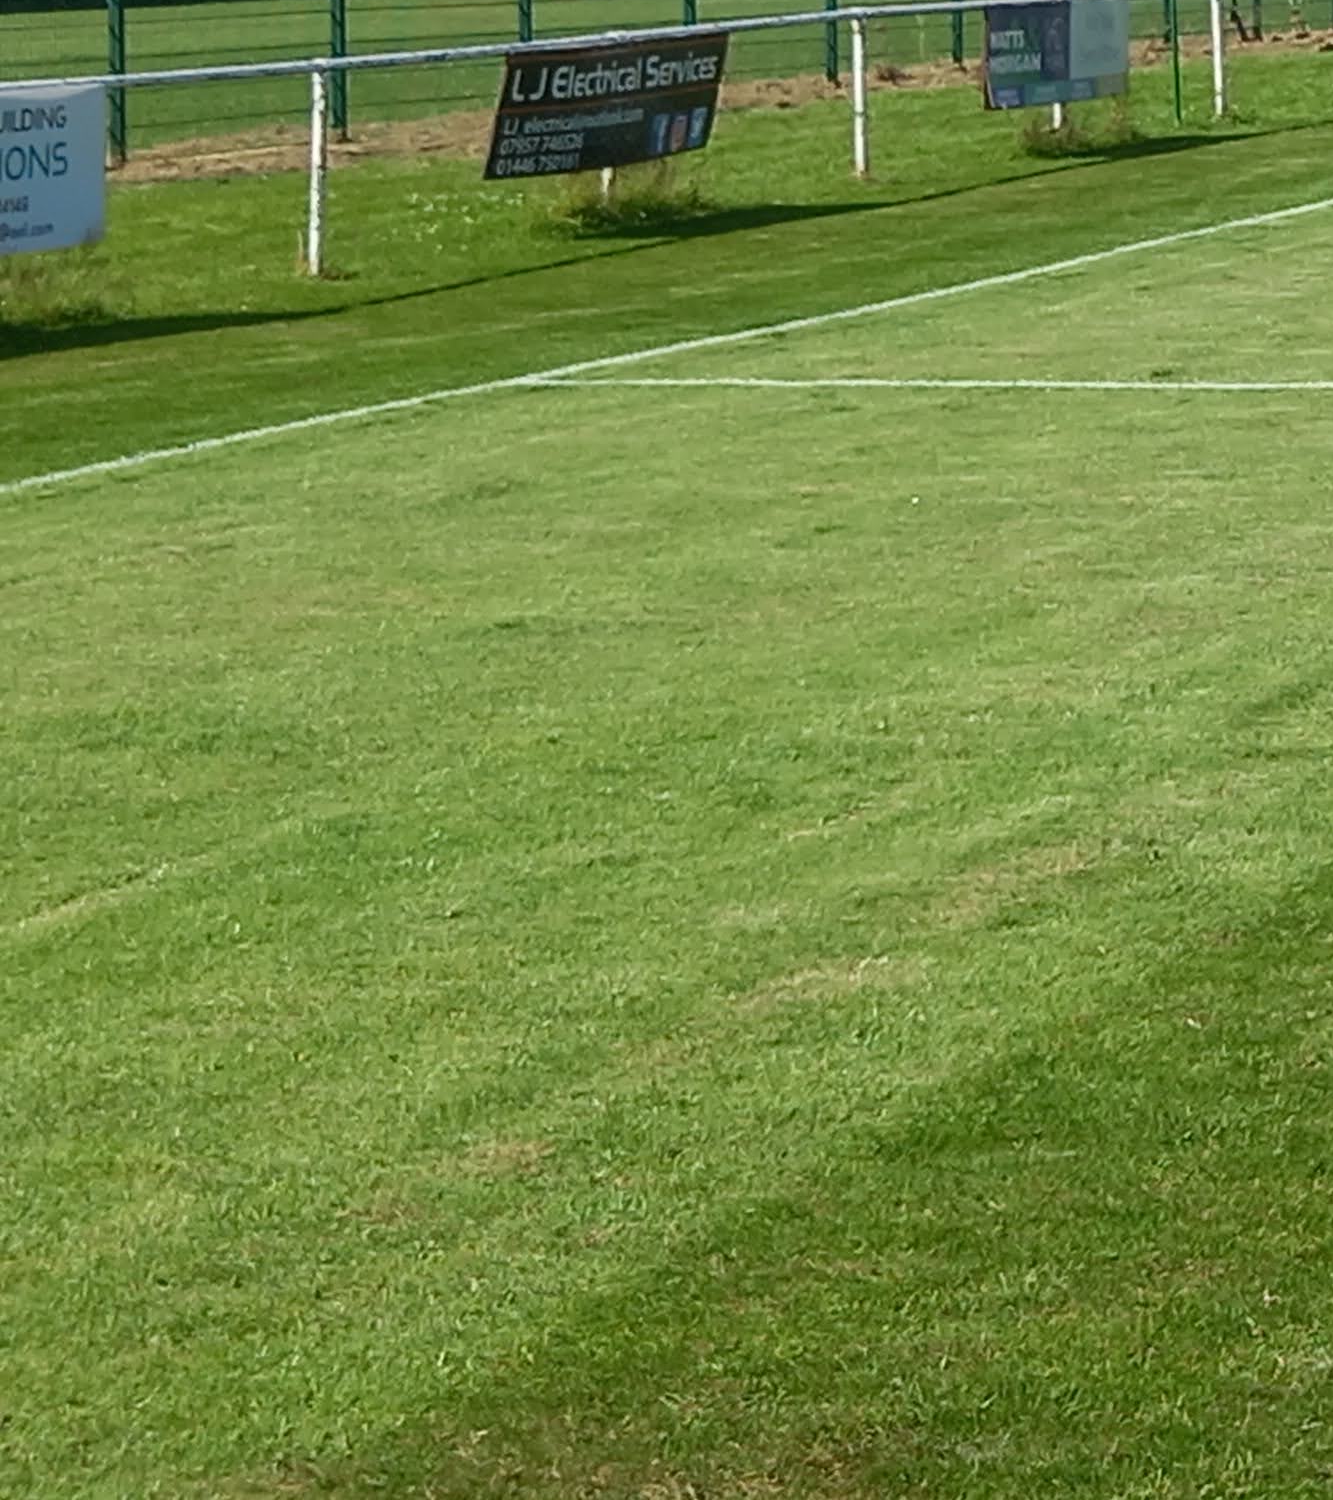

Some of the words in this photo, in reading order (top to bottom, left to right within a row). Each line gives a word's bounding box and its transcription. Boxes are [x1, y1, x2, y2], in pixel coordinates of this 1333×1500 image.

[511, 68, 525, 102] L
[529, 67, 549, 101] J
[551, 57, 643, 99] Electrical
[645, 51, 719, 88] Services
